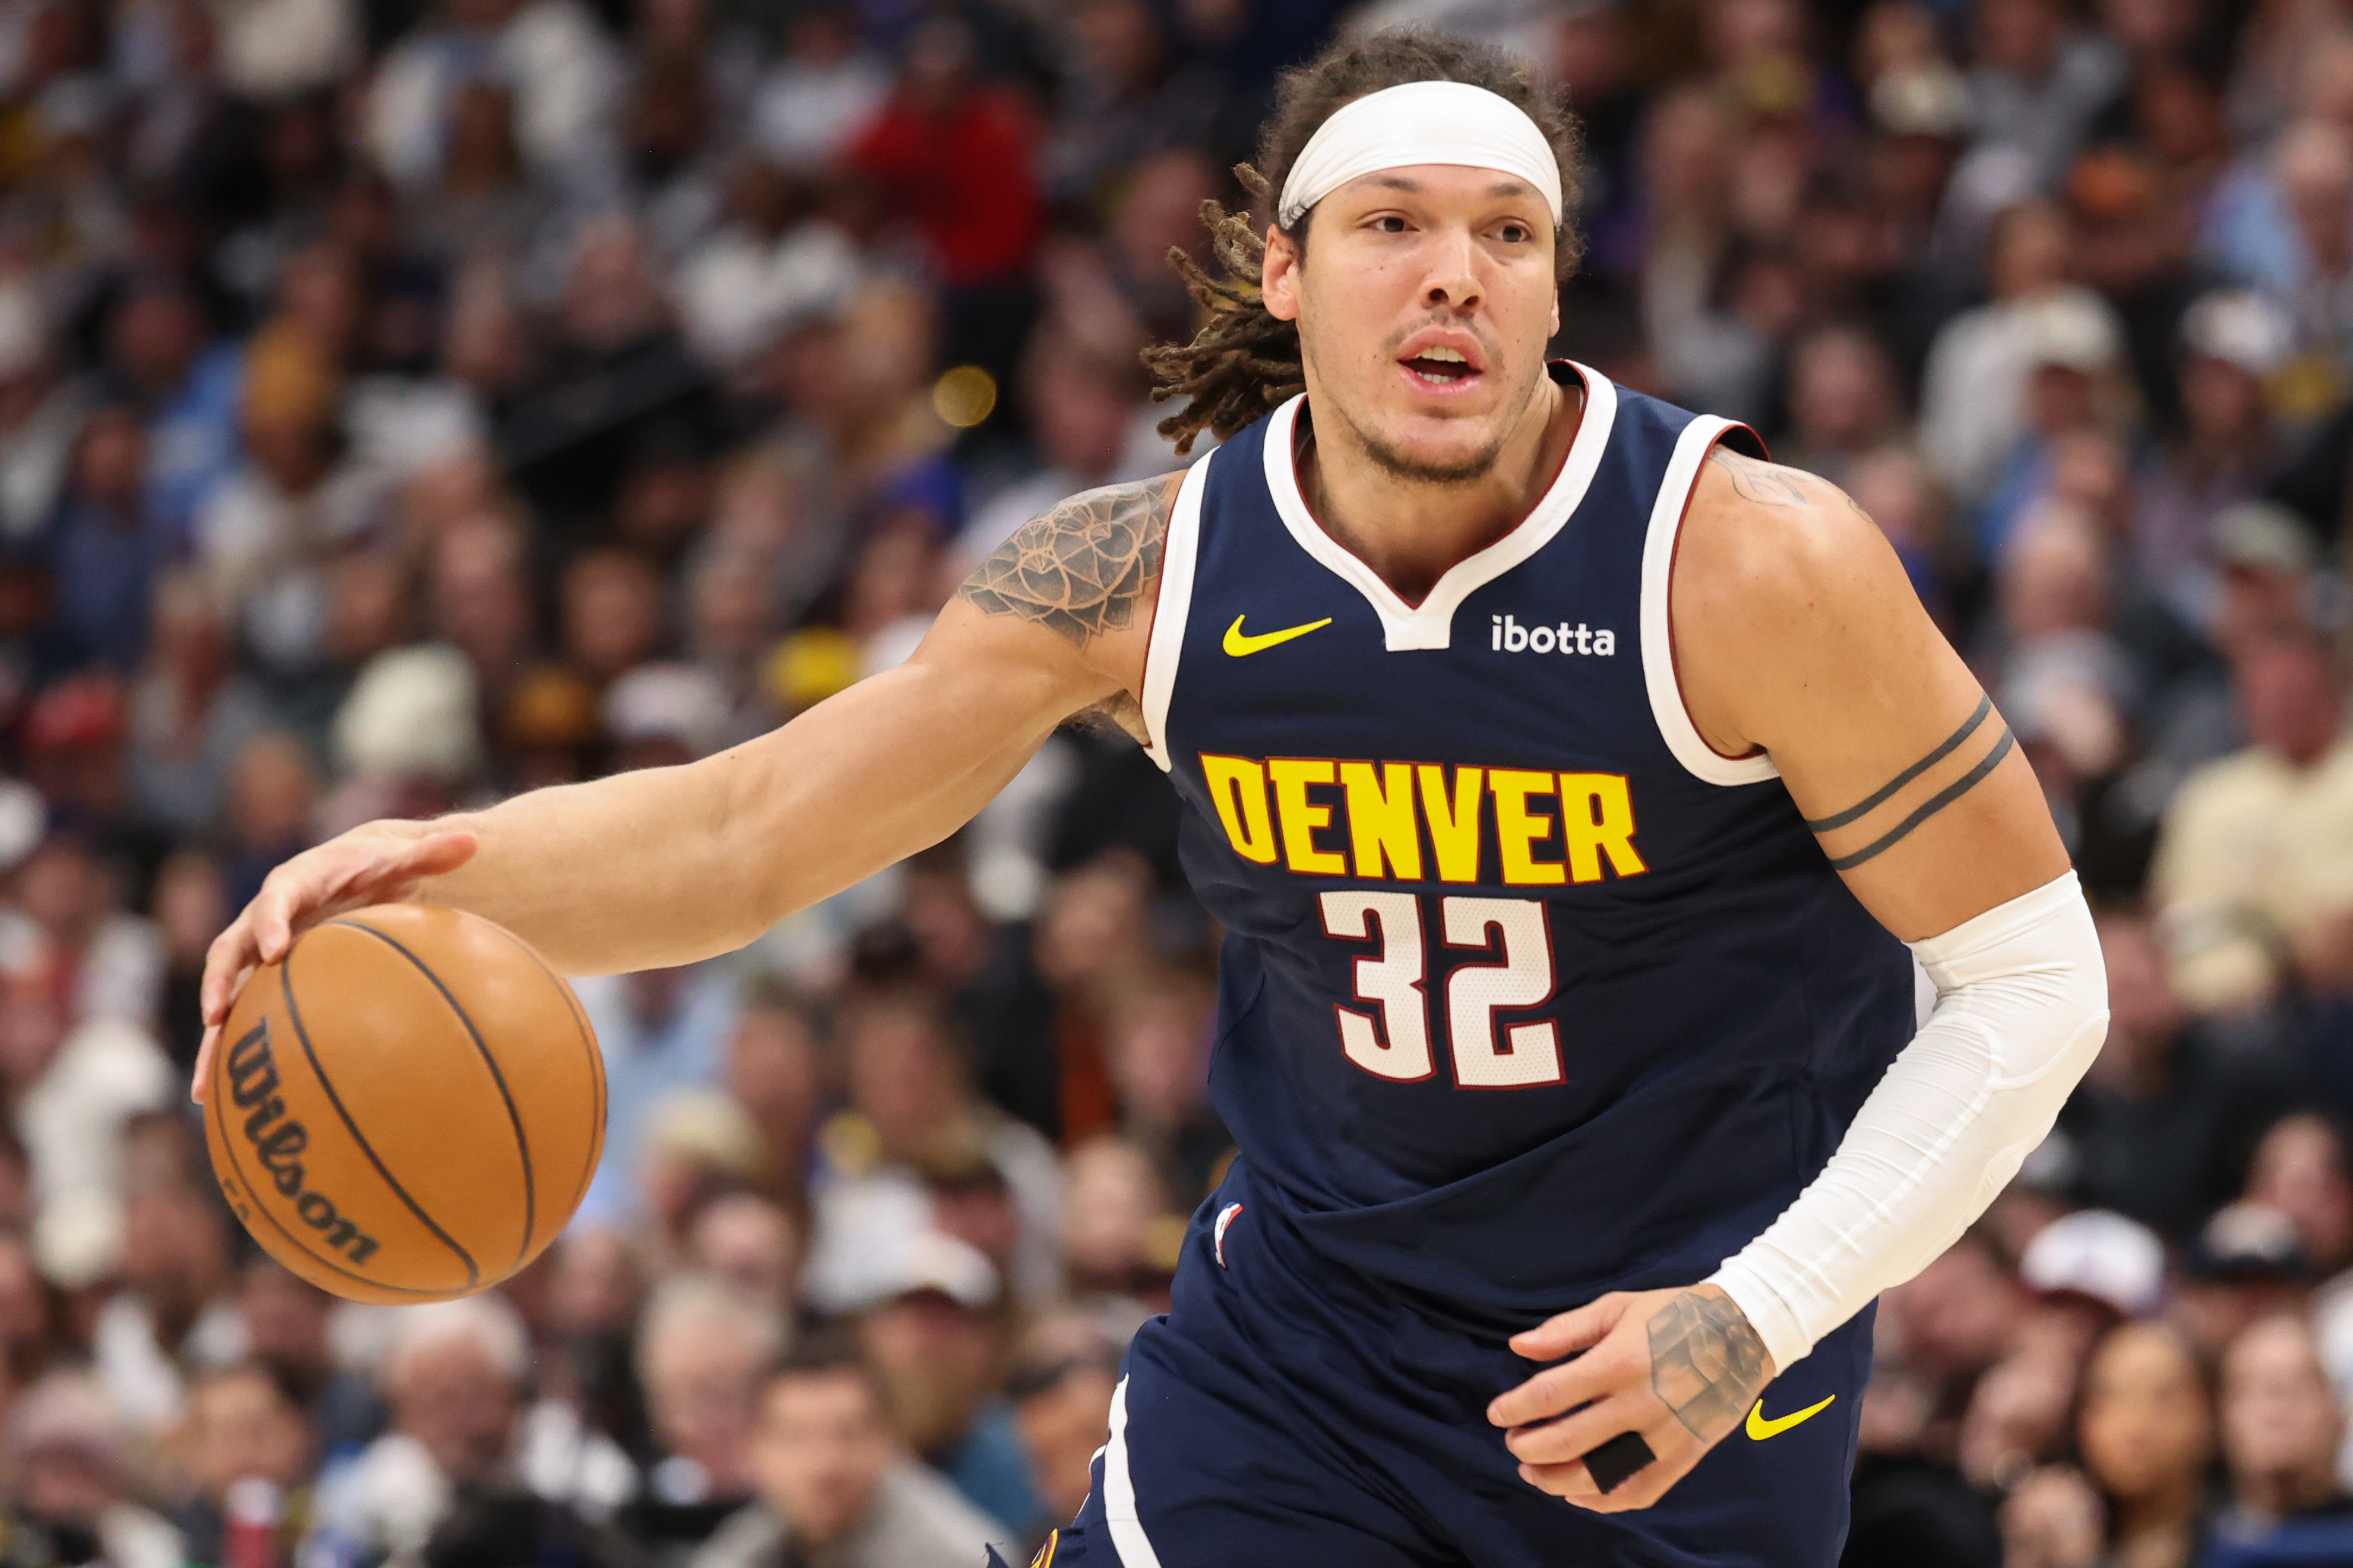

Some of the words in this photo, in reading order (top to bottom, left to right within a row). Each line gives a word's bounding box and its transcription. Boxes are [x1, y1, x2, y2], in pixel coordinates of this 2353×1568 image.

[1492, 614, 1615, 656] ibotta
[1198, 752, 1649, 885] DENVER
[1318, 890, 1567, 1089] 32
[226, 1015, 380, 1266] Wilson
